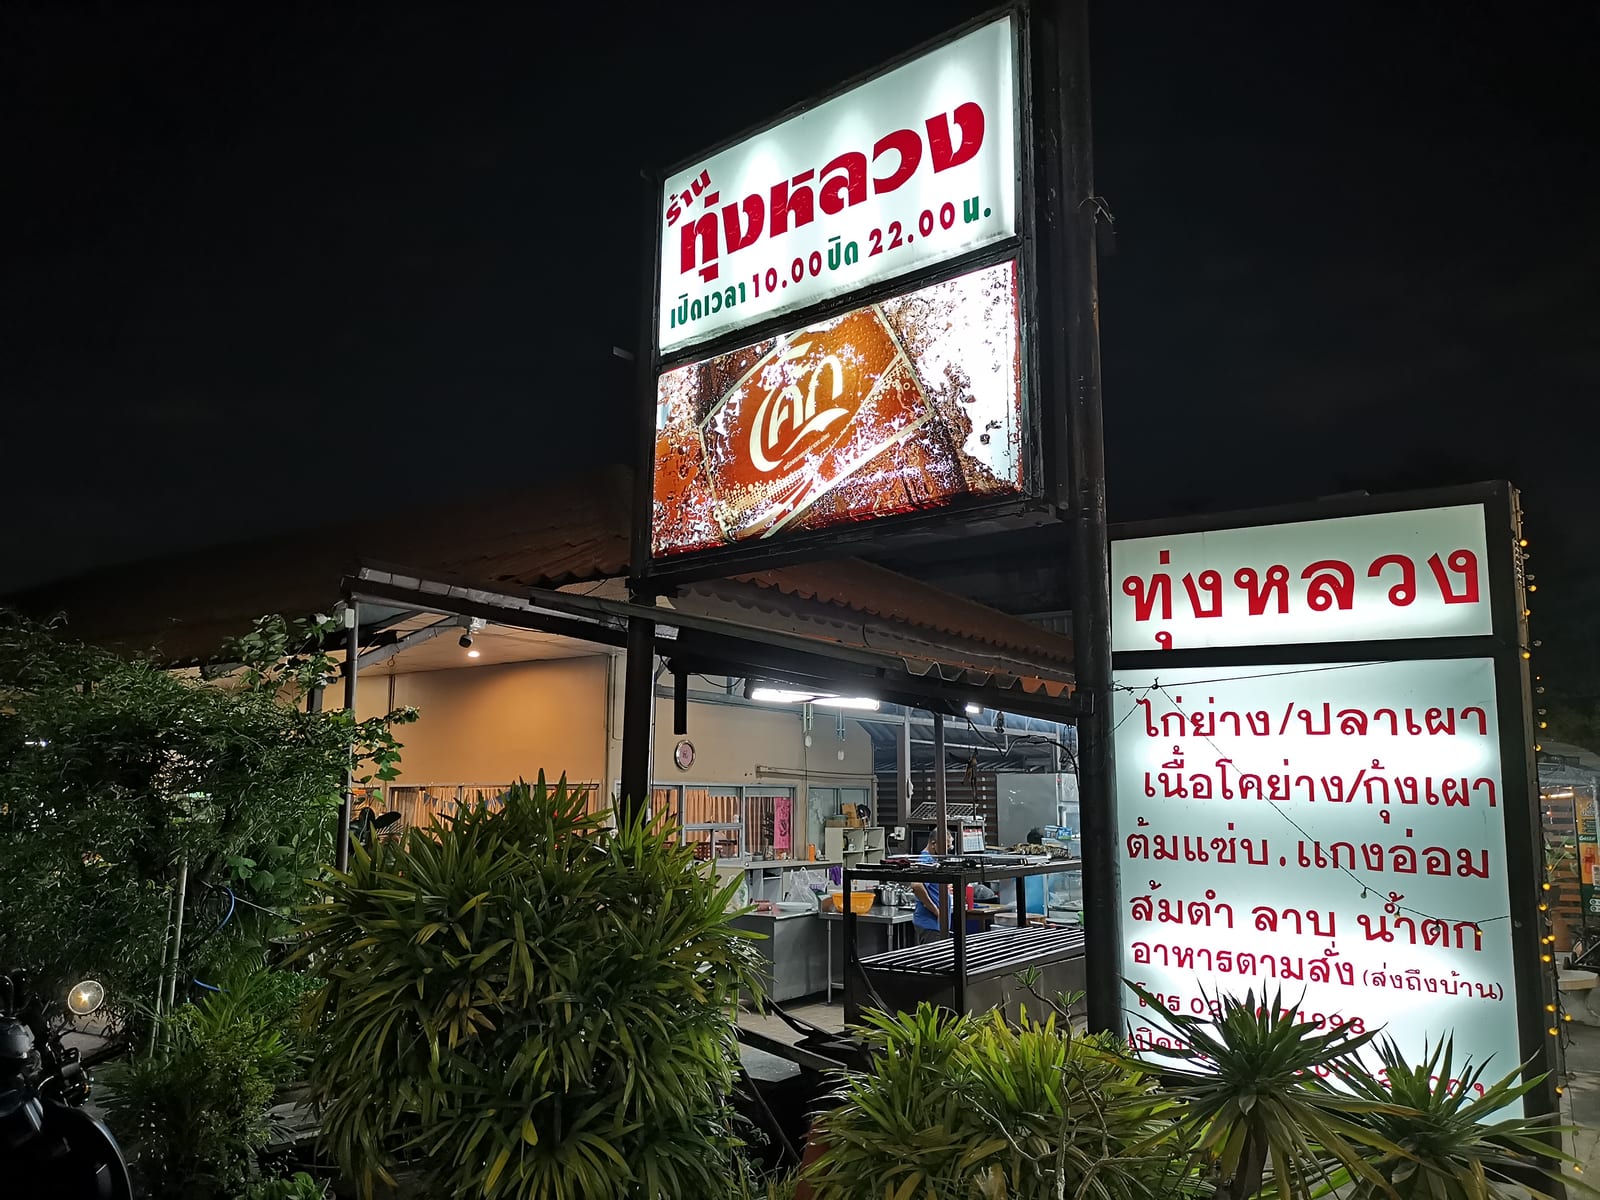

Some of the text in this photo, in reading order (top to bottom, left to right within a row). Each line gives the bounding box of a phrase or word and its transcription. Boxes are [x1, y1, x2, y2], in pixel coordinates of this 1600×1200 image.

[666, 168, 711, 227] ร้าน
[681, 101, 986, 283] ทุ่งหลวง
[670, 195, 992, 329] เปิดเวลา 10.00 ปิด 22.00 น.
[1122, 549, 1481, 651] ทุ่งหลวง
[1130, 879, 1483, 952] ส้มตำ ลาบ น้ำตก
[1131, 940, 1504, 1001] อาหารตามสั่ง (ส่งถึงบ้าน)
